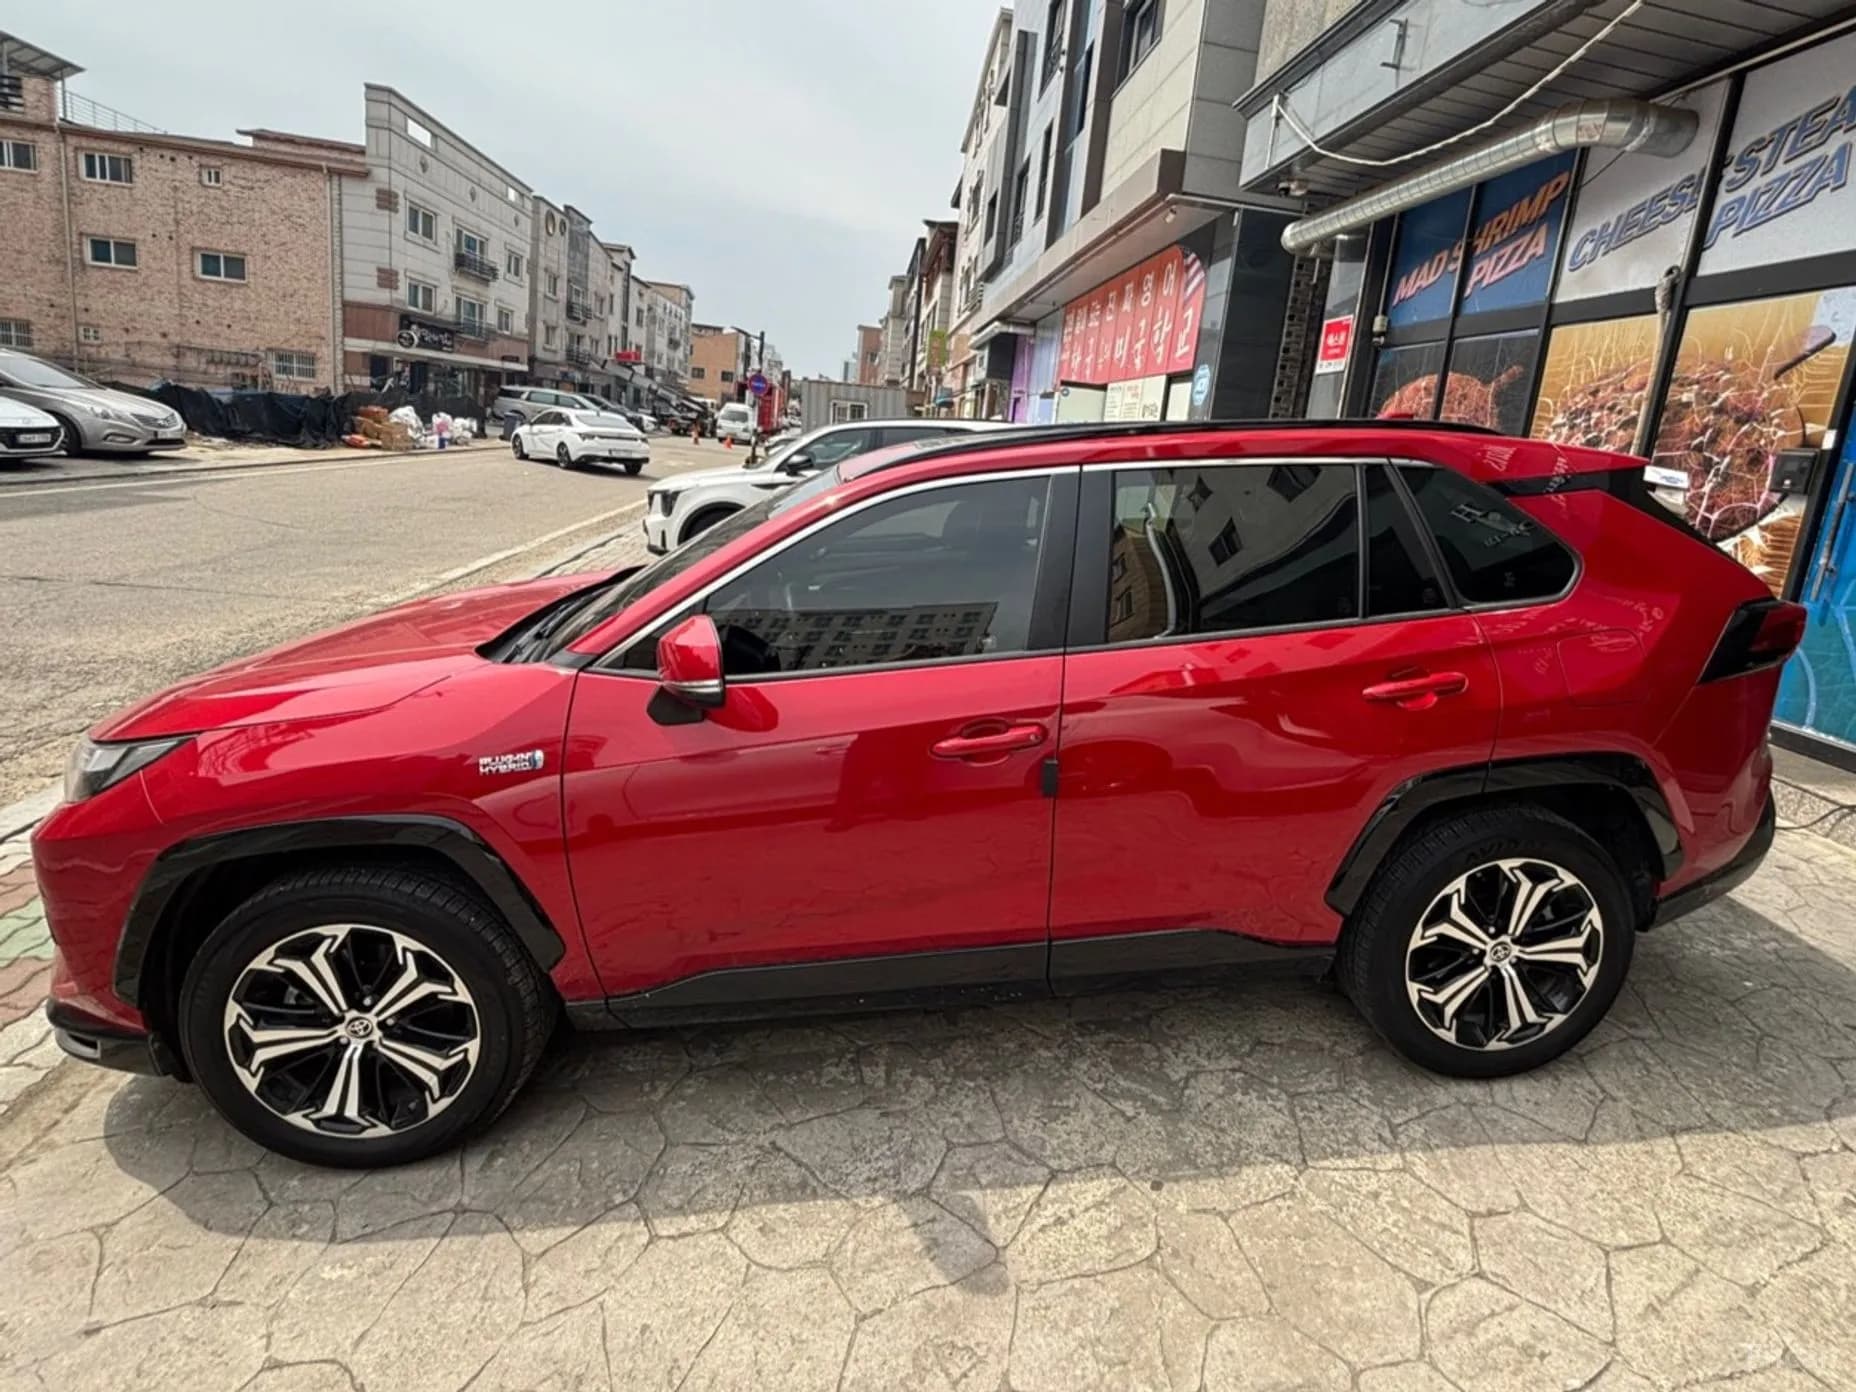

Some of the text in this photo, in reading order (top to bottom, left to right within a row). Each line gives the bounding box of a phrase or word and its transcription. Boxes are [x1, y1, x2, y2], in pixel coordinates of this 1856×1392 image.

[1702, 143, 1852, 250] PIZZA
[1392, 250, 1449, 306] MAD
[1464, 224, 1548, 299] PIZZA
